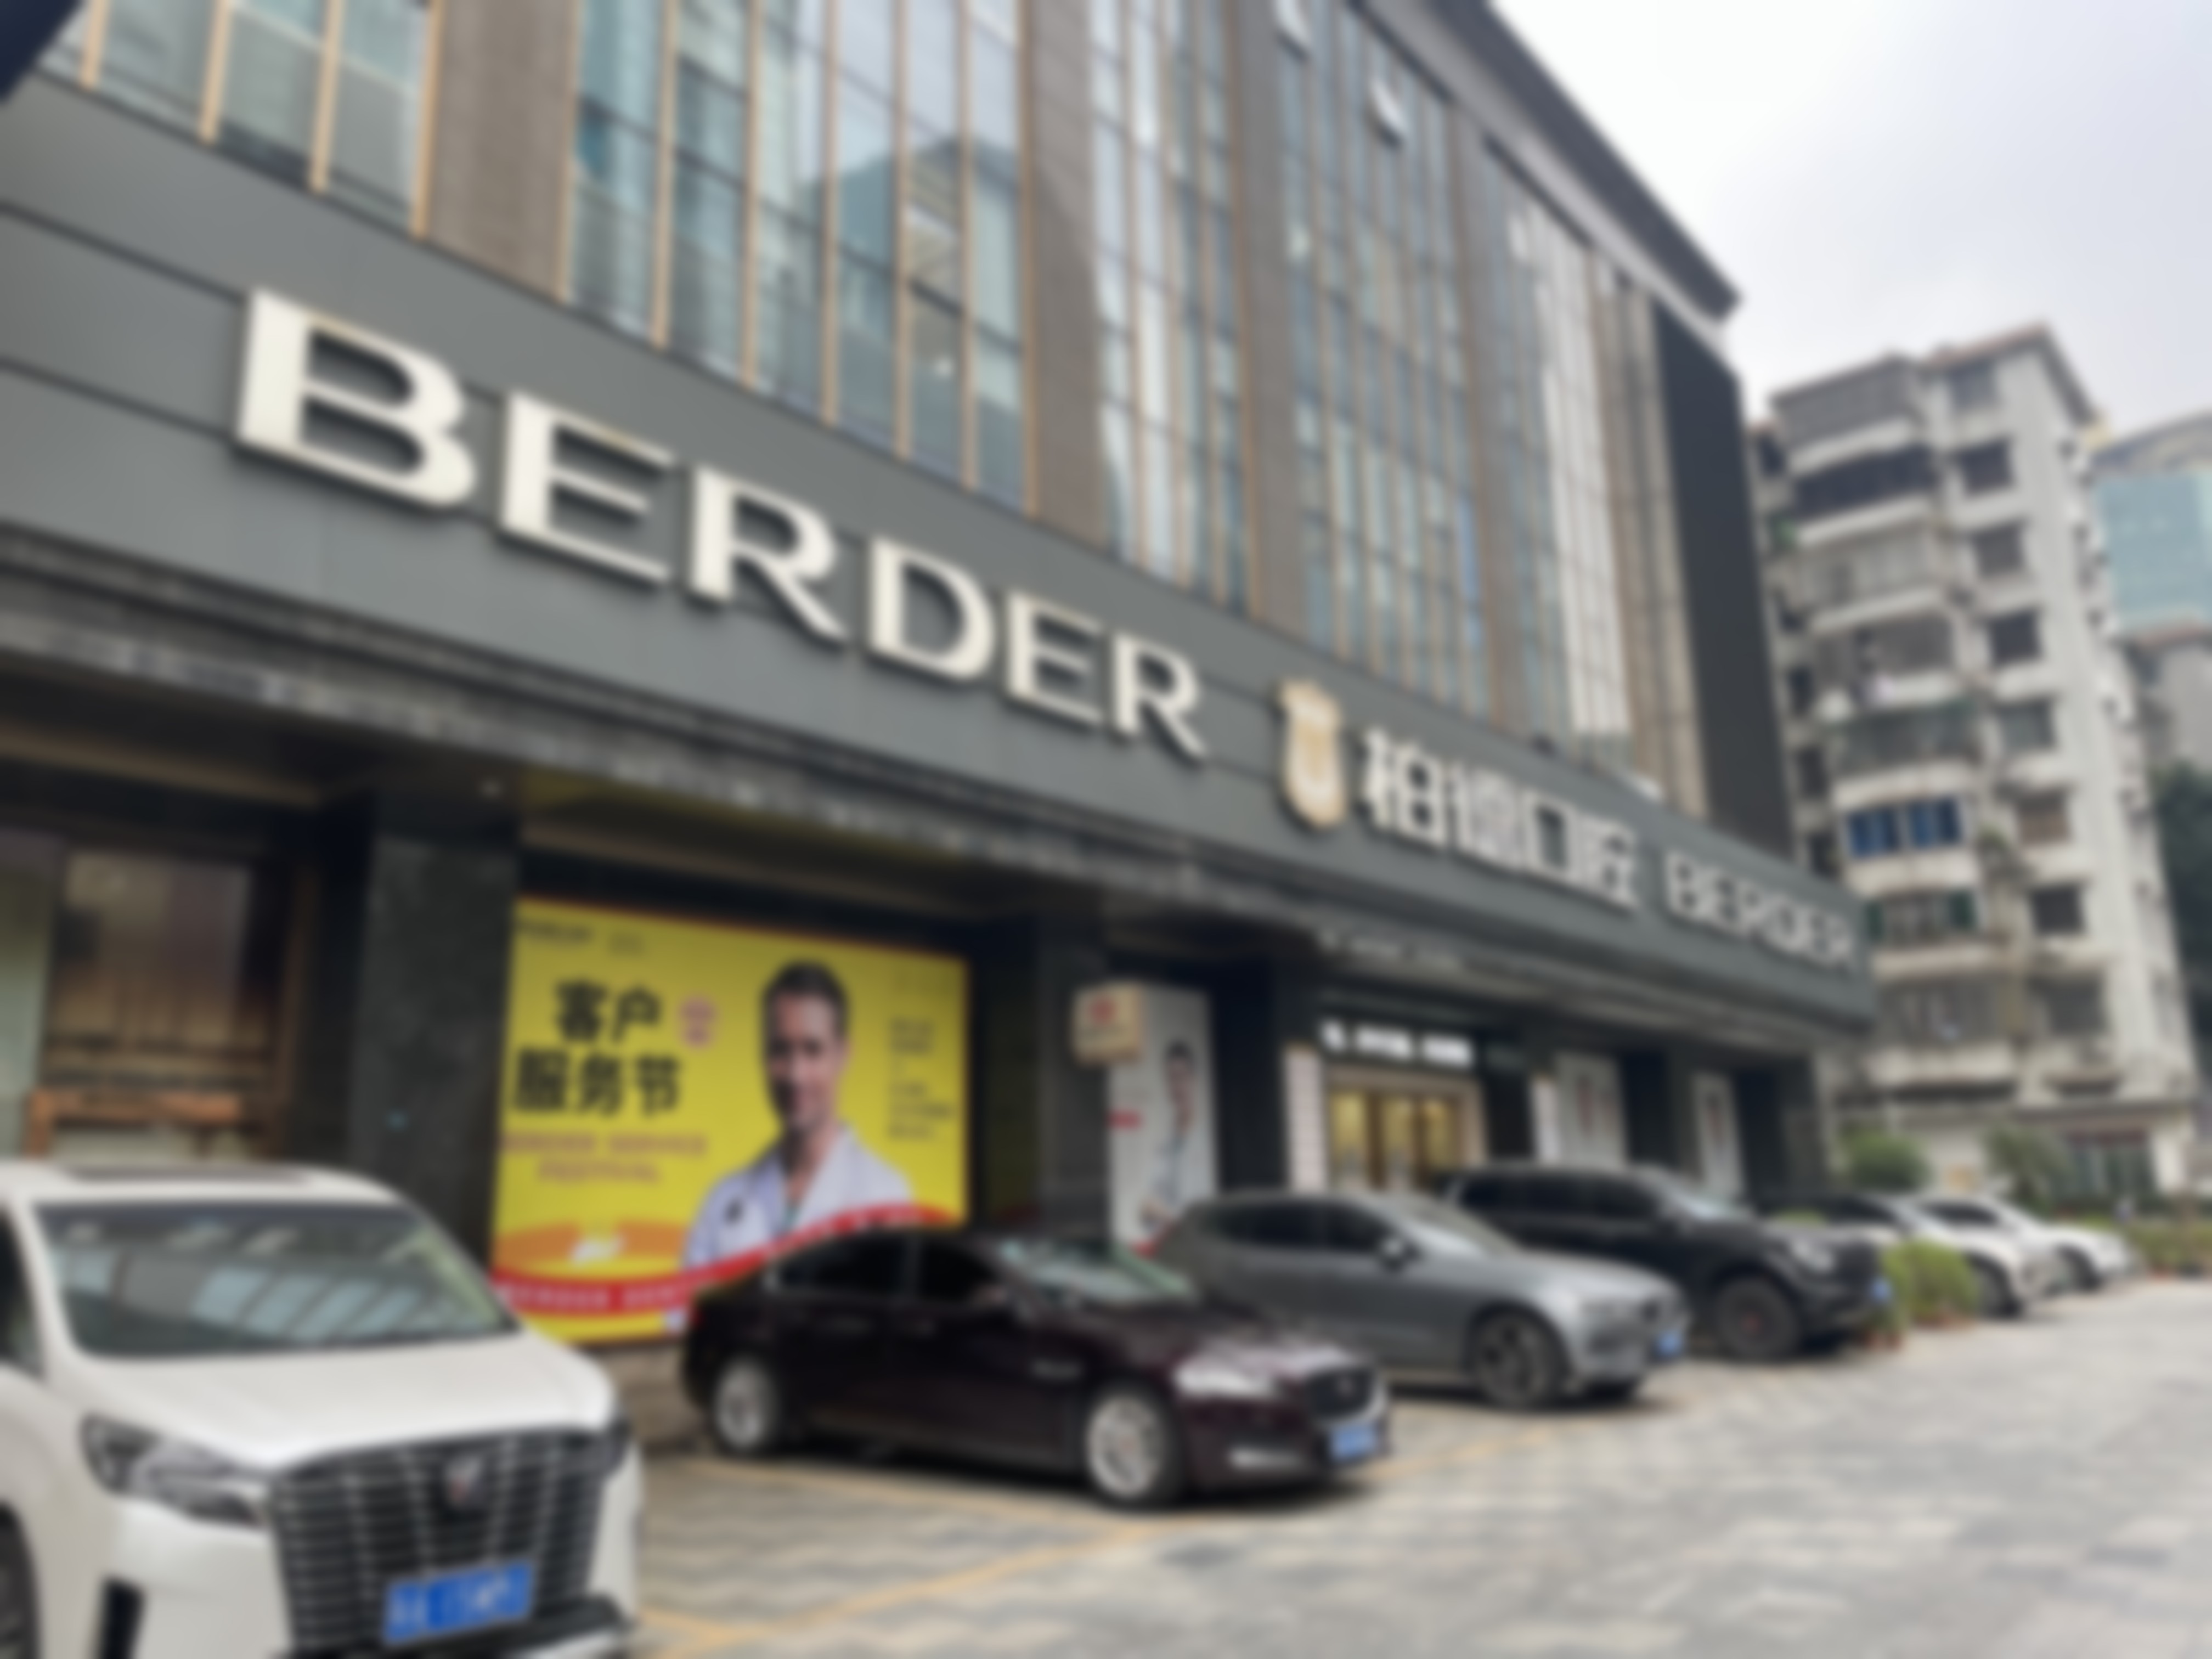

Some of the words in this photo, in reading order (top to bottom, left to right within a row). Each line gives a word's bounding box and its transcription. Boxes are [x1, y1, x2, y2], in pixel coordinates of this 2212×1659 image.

[236, 289, 1208, 760] BERDER
[1666, 850, 1855, 973] BERDER
[554, 979, 663, 1045] 客户
[512, 1046, 681, 1117] 服务节
